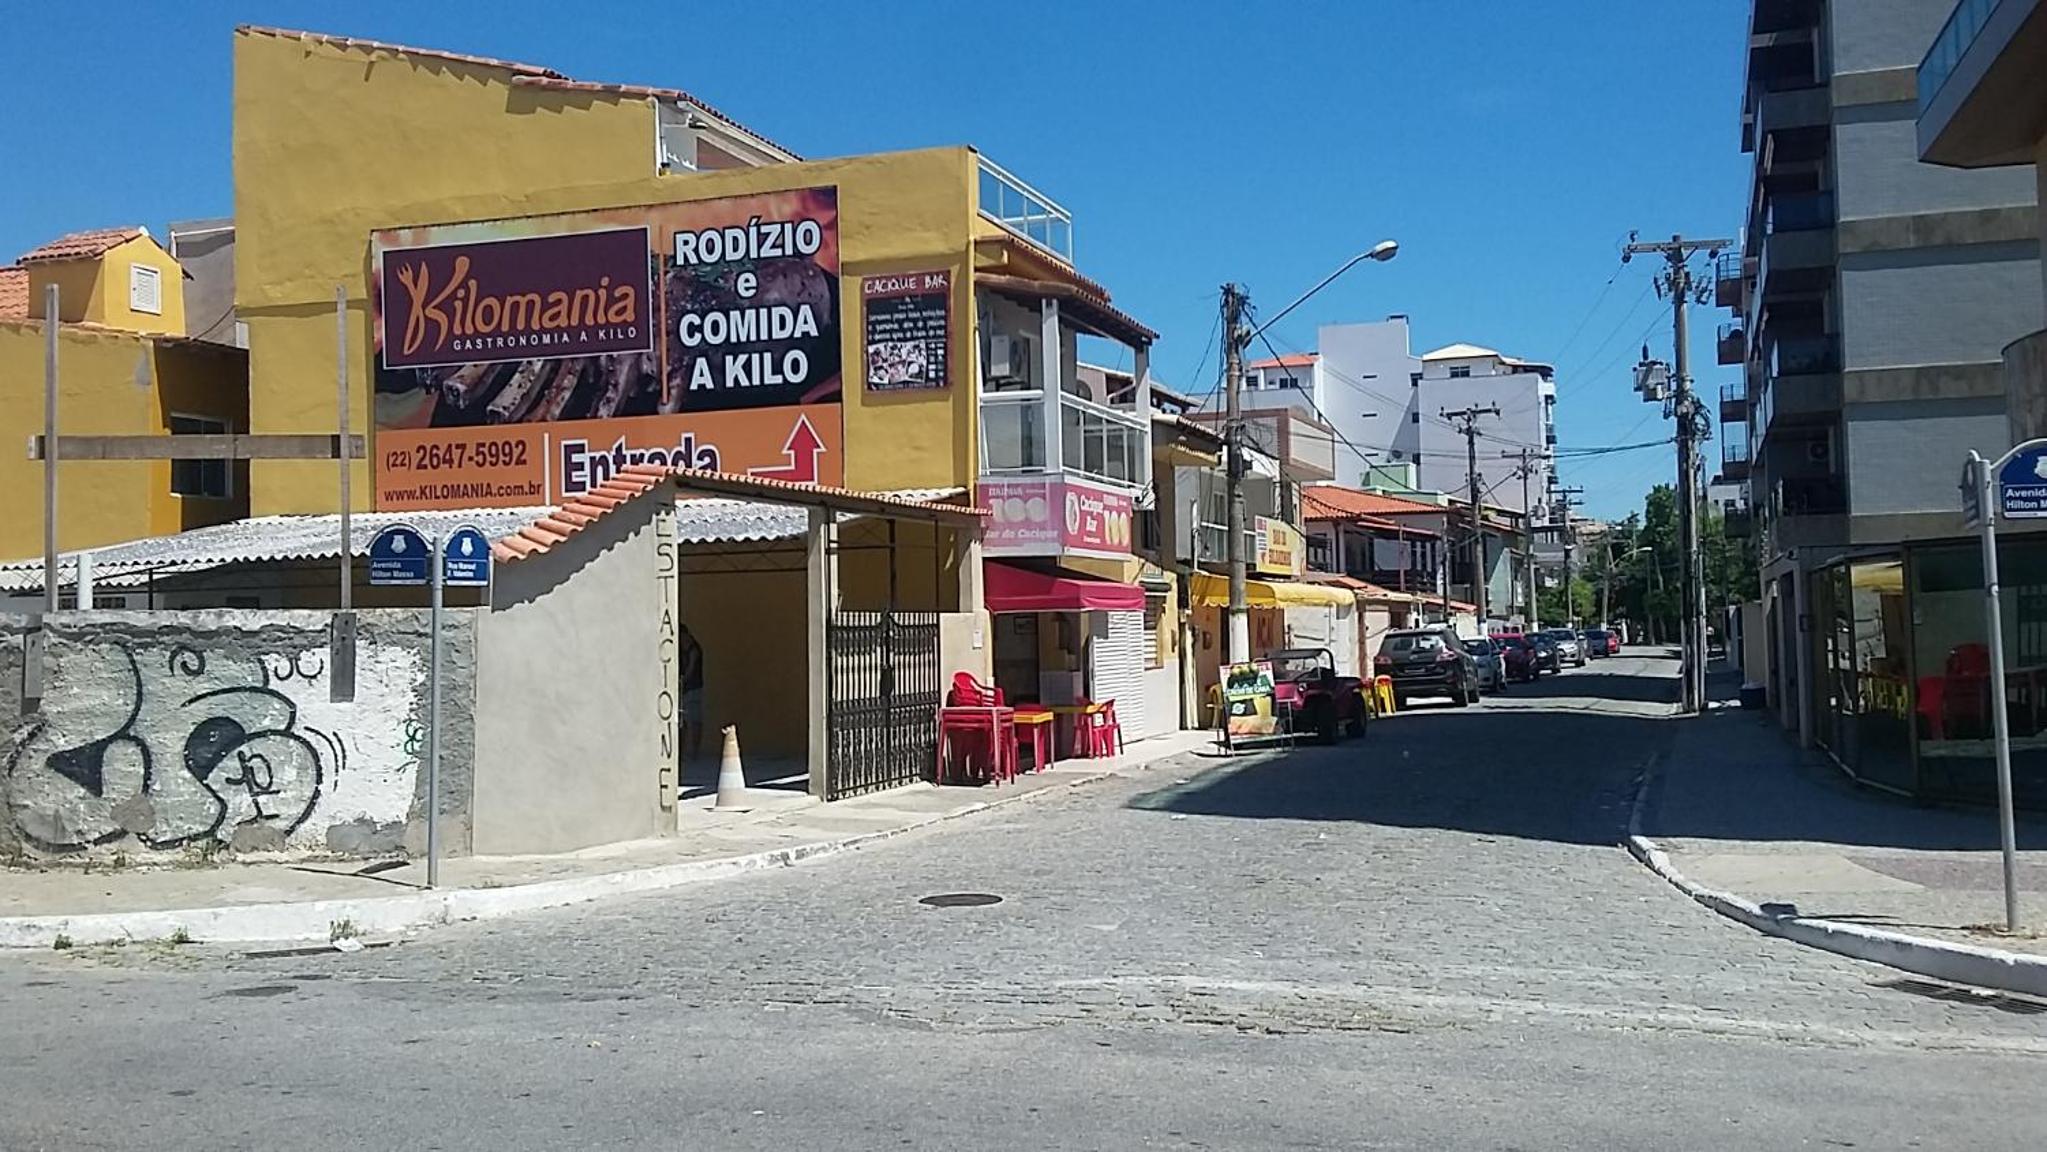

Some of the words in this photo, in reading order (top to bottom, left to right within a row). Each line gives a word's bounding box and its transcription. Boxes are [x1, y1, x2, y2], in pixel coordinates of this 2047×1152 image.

[674, 217, 822, 266] RODÍZIO
[736, 271, 758, 298] e
[864, 277, 917, 294] CACIQUE
[924, 275, 948, 289] BAR
[397, 255, 637, 356] Kilomania
[453, 332, 570, 351] GASTRONOMIA
[580, 330, 588, 342] A
[599, 326, 637, 341] KILO
[679, 304, 819, 347] COMIDA
[689, 356, 715, 391] A
[725, 349, 809, 388] KILO
[386, 451, 412, 472] (22)
[415, 439, 528, 470] 2647-5992
[384, 480, 543, 502] www.KILOMANIA.com.br
[2005, 487, 2047, 498] Avenid
[2006, 500, 2039, 509] Hilton
[372, 561, 402, 569] Avenida
[655, 518, 675, 813] ESTACIONE
